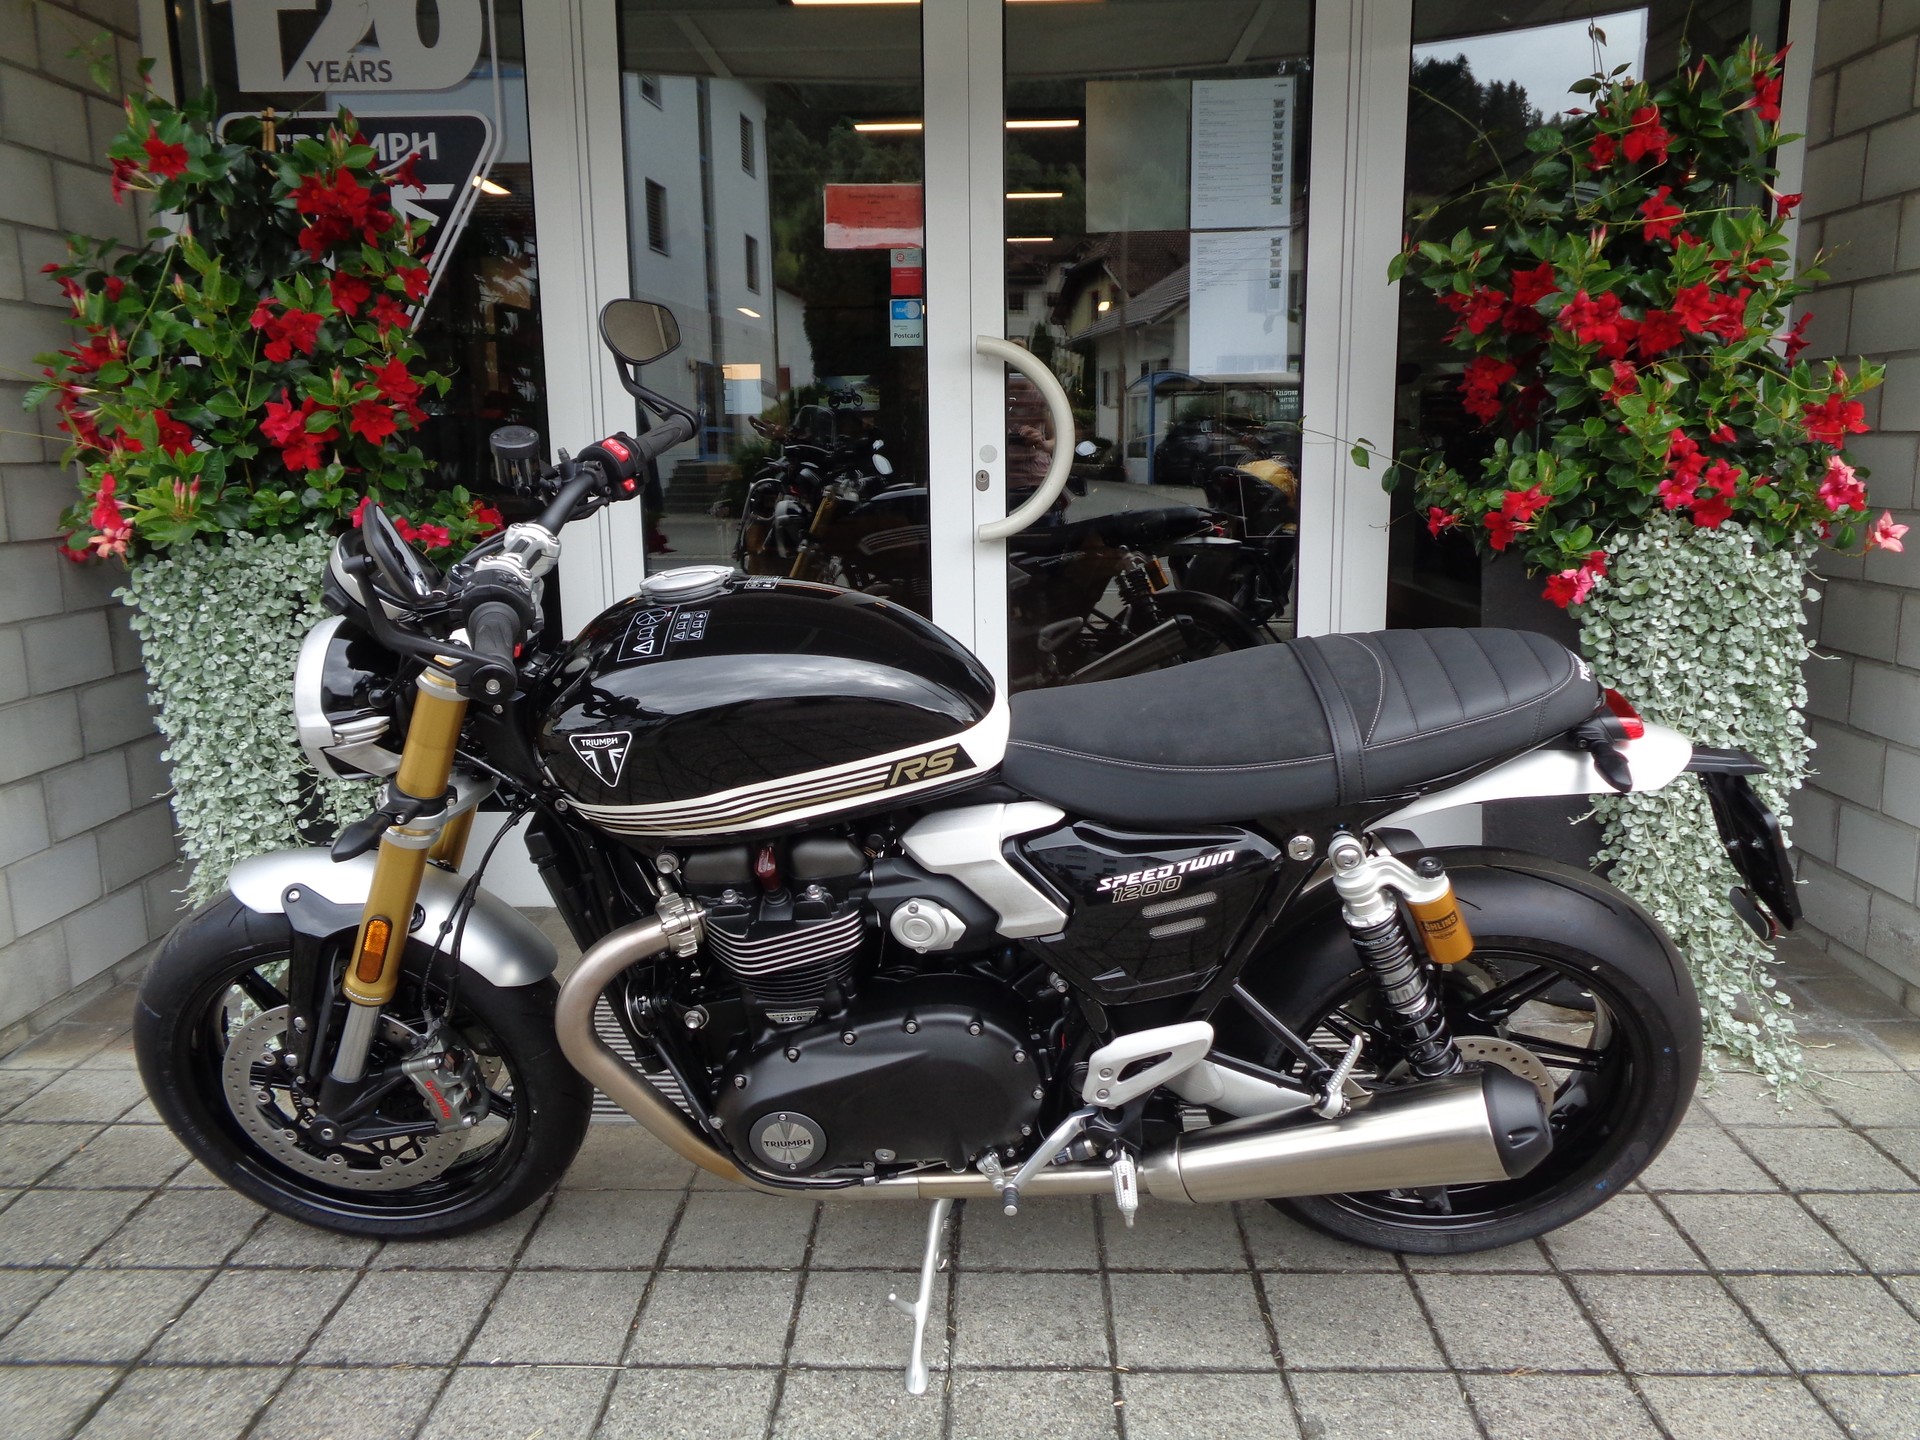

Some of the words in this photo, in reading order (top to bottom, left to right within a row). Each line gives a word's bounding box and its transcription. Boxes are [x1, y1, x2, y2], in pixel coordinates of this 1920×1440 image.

[306, 60, 393, 83] YEARS
[580, 737, 619, 748] TRIUMPH
[889, 747, 958, 786] RS
[1096, 864, 1176, 892] SPEED
[1177, 849, 1235, 874] TWIN
[1112, 875, 1183, 904] 1200
[780, 1015, 803, 1023] 1200
[424, 1079, 452, 1119] brembo
[763, 1139, 811, 1149] TRIUMPH
